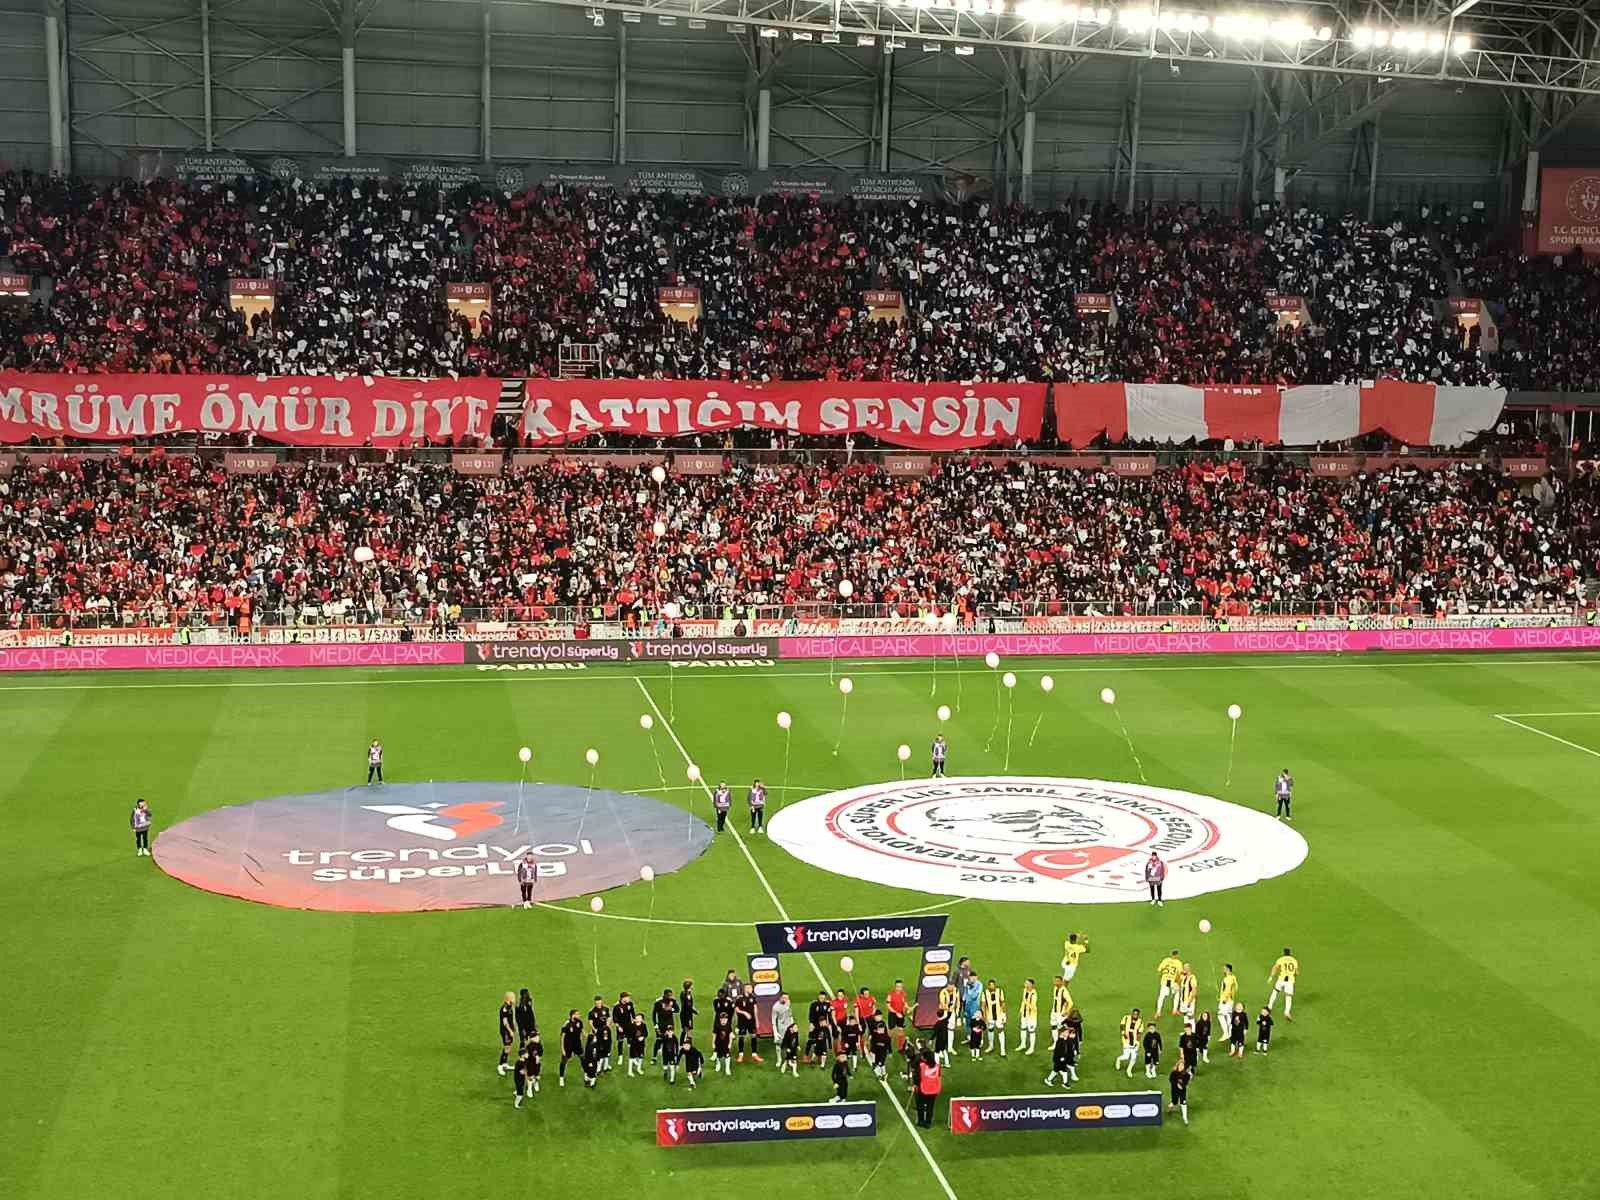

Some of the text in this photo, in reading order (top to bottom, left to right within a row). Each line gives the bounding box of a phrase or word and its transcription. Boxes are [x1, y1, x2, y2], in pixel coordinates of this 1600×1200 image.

[200, 383, 353, 438] ÖMÜR
[371, 391, 489, 438] DİYE
[819, 390, 1018, 437] SENSİN
[796, 637, 919, 656] MEDICALPARK
[942, 635, 1063, 654] MEDICALPARK
[1094, 633, 1213, 652] MEDICALPARK
[1233, 632, 1350, 651] MEDICALPARK
[1379, 630, 1494, 649] MEDICALPARK
[145, 648, 283, 667] MEDICALPARK
[310, 645, 446, 664] MEDICALPARK
[492, 643, 565, 661] trendyol
[646, 641, 716, 659] trendyol
[1149, 816, 1193, 852] SEZONU
[282, 839, 594, 866] trendyol
[856, 825, 1000, 864] TRENDYOL
[960, 856, 1237, 884] 2024 2025
[806, 926, 870, 943] trendyol
[1284, 962, 1295, 972] 10
[980, 1107, 1030, 1122] trendyol
[686, 1118, 738, 1133] trendyol
